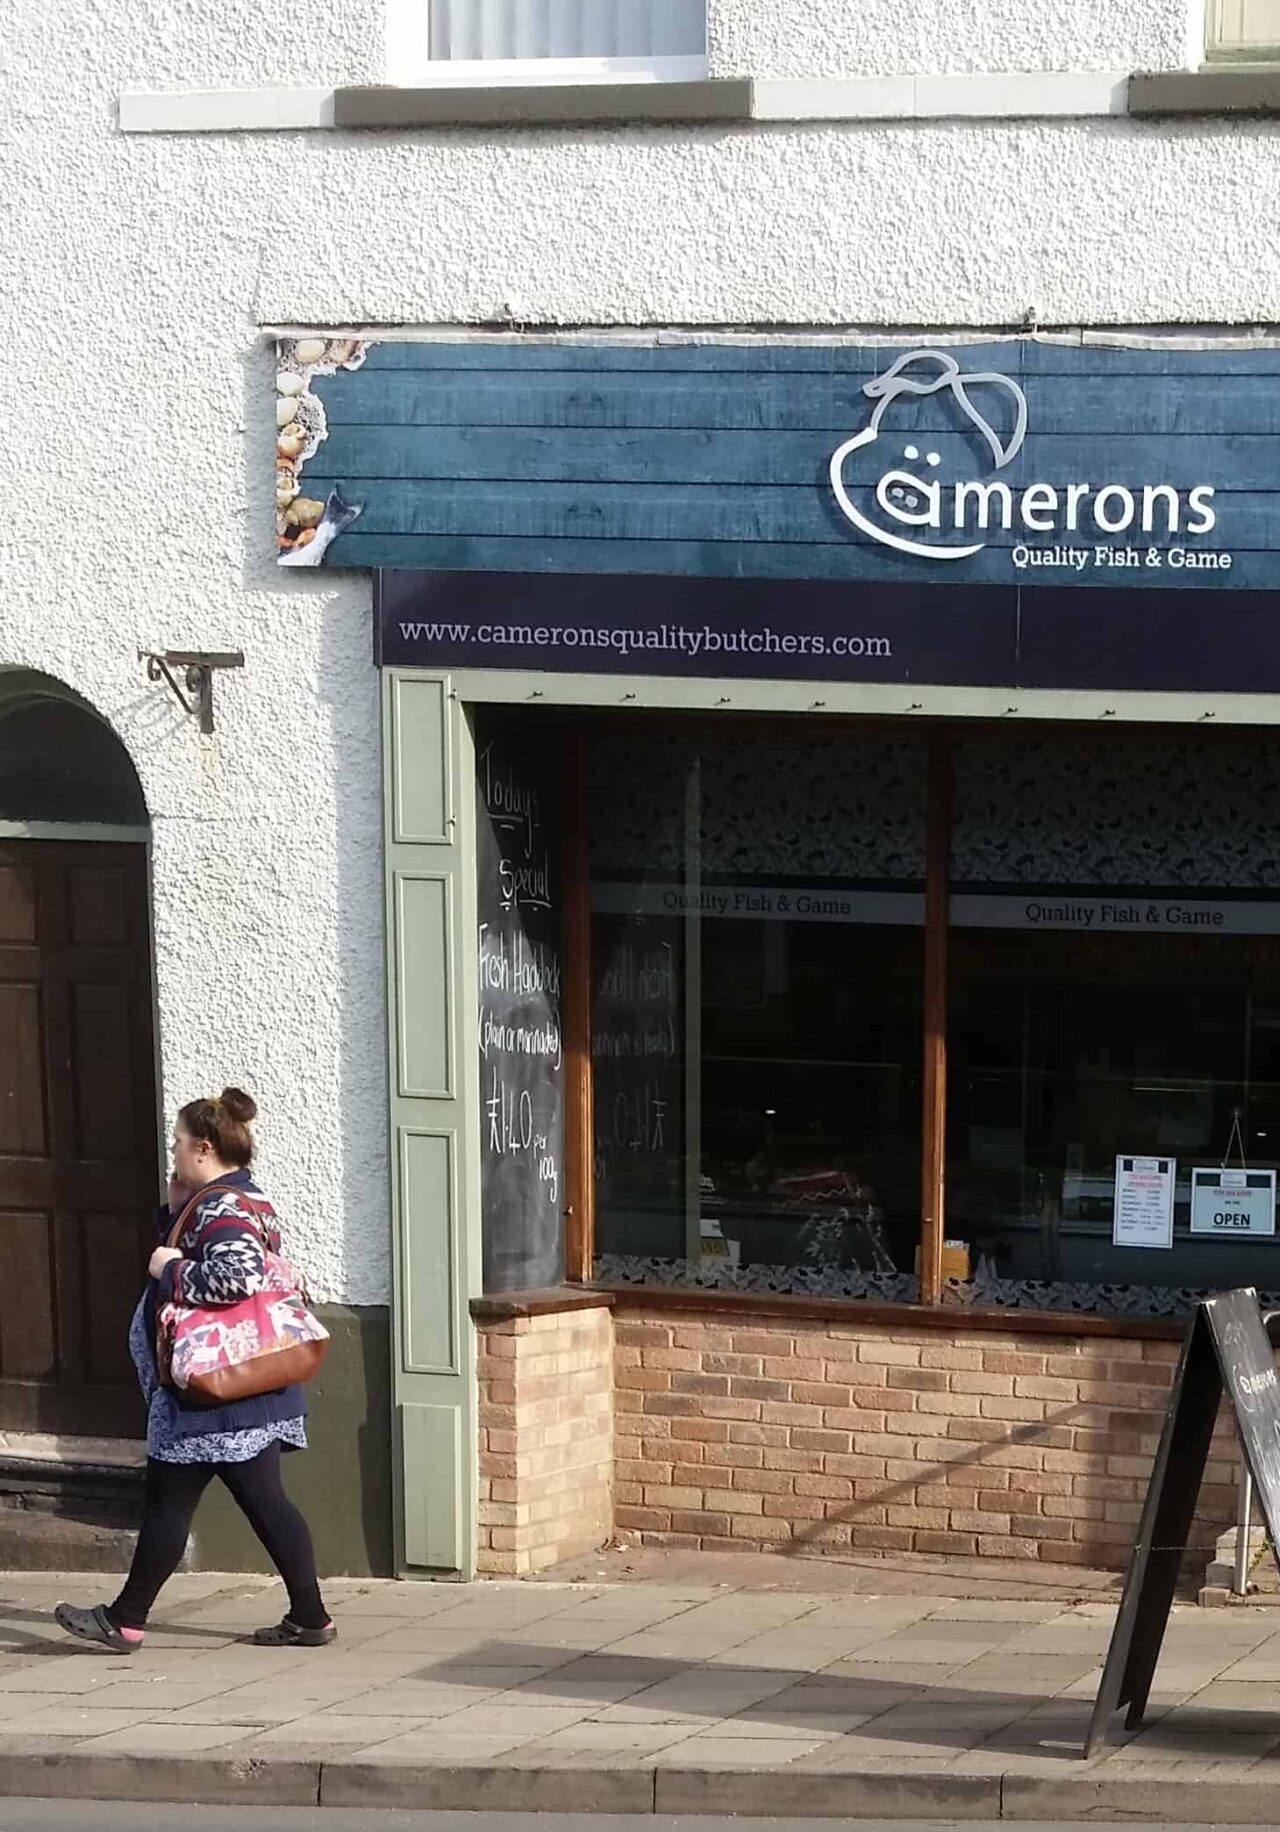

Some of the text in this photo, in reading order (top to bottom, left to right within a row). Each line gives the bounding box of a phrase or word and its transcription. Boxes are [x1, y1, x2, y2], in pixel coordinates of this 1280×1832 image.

[1012, 545, 1232, 571] Quality Fish & Game
[399, 621, 892, 657] www.cameronsqualitybutchers.com
[662, 890, 851, 915] Quality Fish & Game
[1025, 902, 1223, 926] Quality Fish & Game
[1213, 1212, 1251, 1226] OPEN
